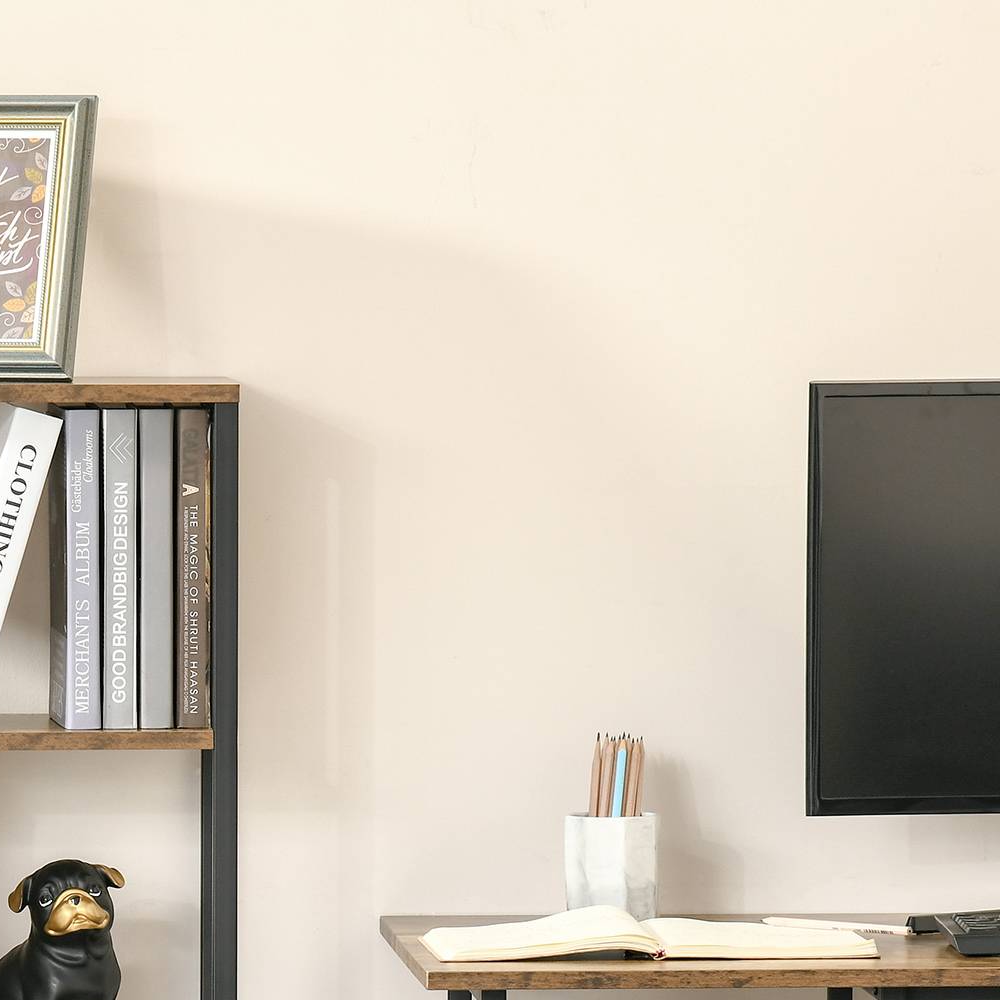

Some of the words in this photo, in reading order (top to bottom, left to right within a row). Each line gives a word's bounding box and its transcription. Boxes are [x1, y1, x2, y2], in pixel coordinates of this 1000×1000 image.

[82, 429, 94, 483] Cloakrooms
[71, 460, 82, 513] Gästebäder
[189, 505, 199, 527] THE
[75, 521, 90, 586] ALBUM
[189, 534, 199, 581] MAGIC
[189, 587, 199, 605] OF
[75, 599, 90, 715] MERCHANTS
[189, 611, 199, 656] SHRUTI
[189, 662, 199, 715] HAASAN
